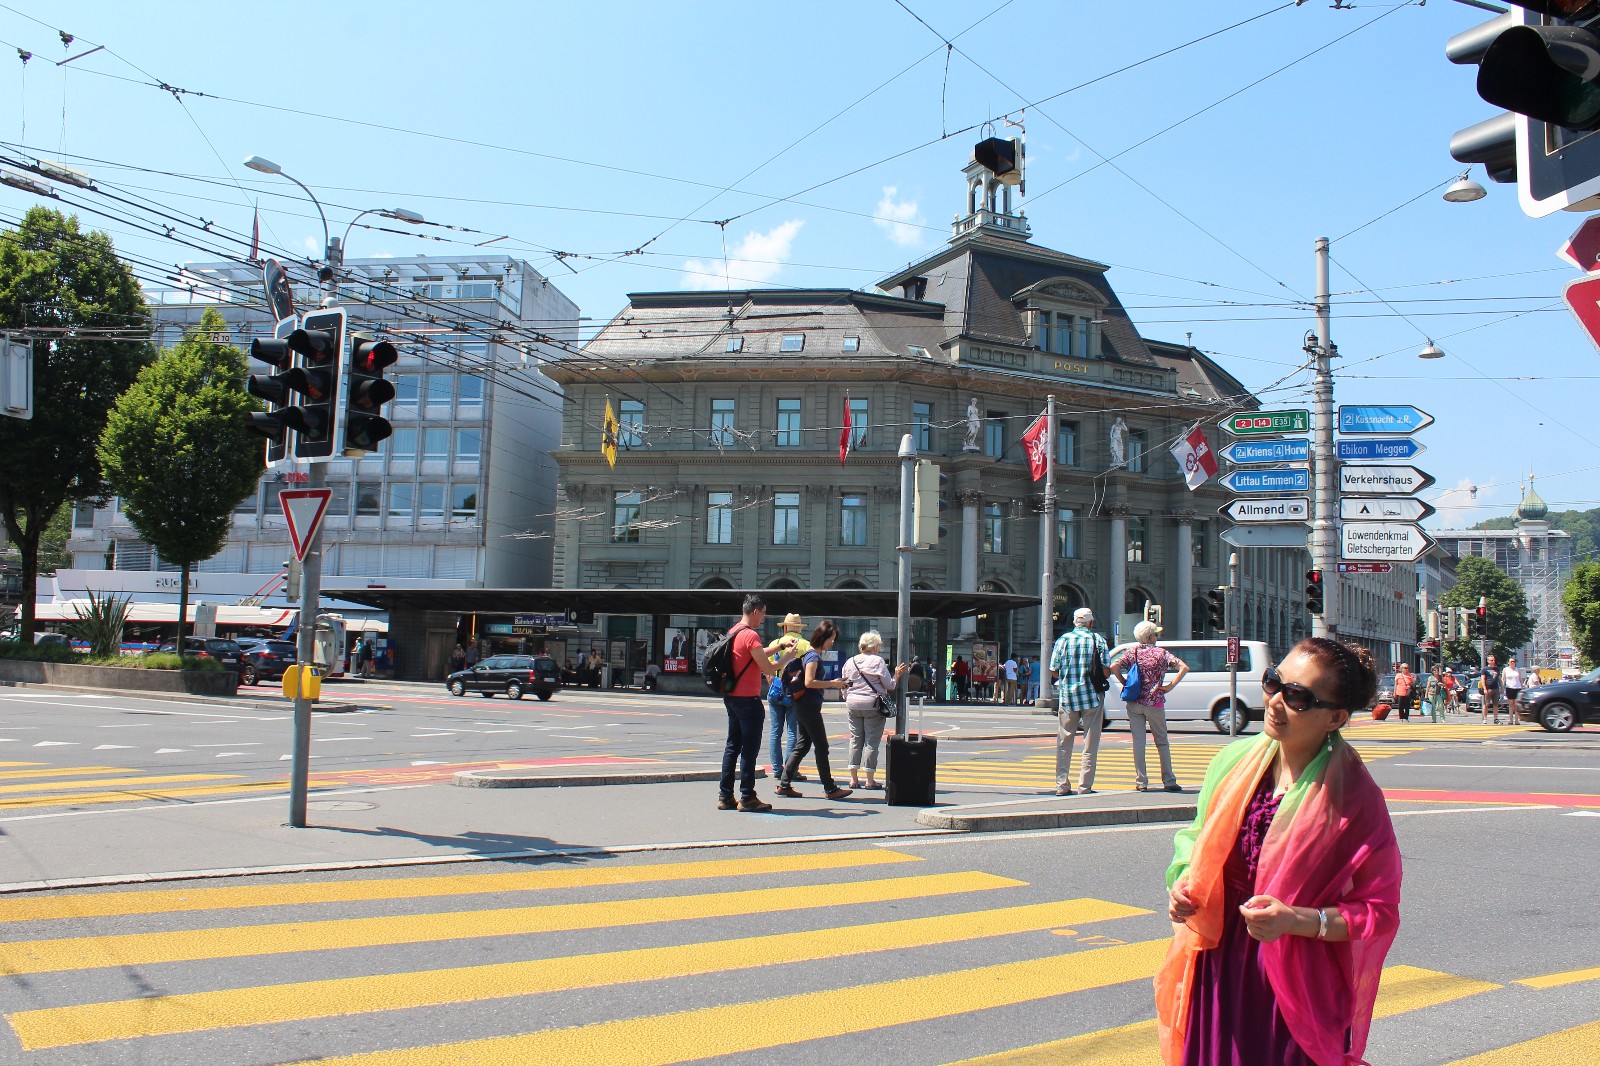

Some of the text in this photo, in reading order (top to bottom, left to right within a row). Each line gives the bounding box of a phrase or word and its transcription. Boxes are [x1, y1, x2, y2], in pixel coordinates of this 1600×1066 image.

[1054, 361, 1089, 374] POST
[1344, 414, 1412, 424] 2 Küssnacht a.R.
[1236, 445, 1307, 457] 2a Kriens 4 Horw
[1341, 444, 1409, 458] Ebikon Meggen
[1235, 474, 1304, 486] Littau Emmen 2
[1344, 474, 1413, 485] Verkehrshaus
[1238, 504, 1285, 516] Allmend
[1348, 529, 1409, 541] Löwendenkmal
[1348, 542, 1413, 556] Gletschergarten
